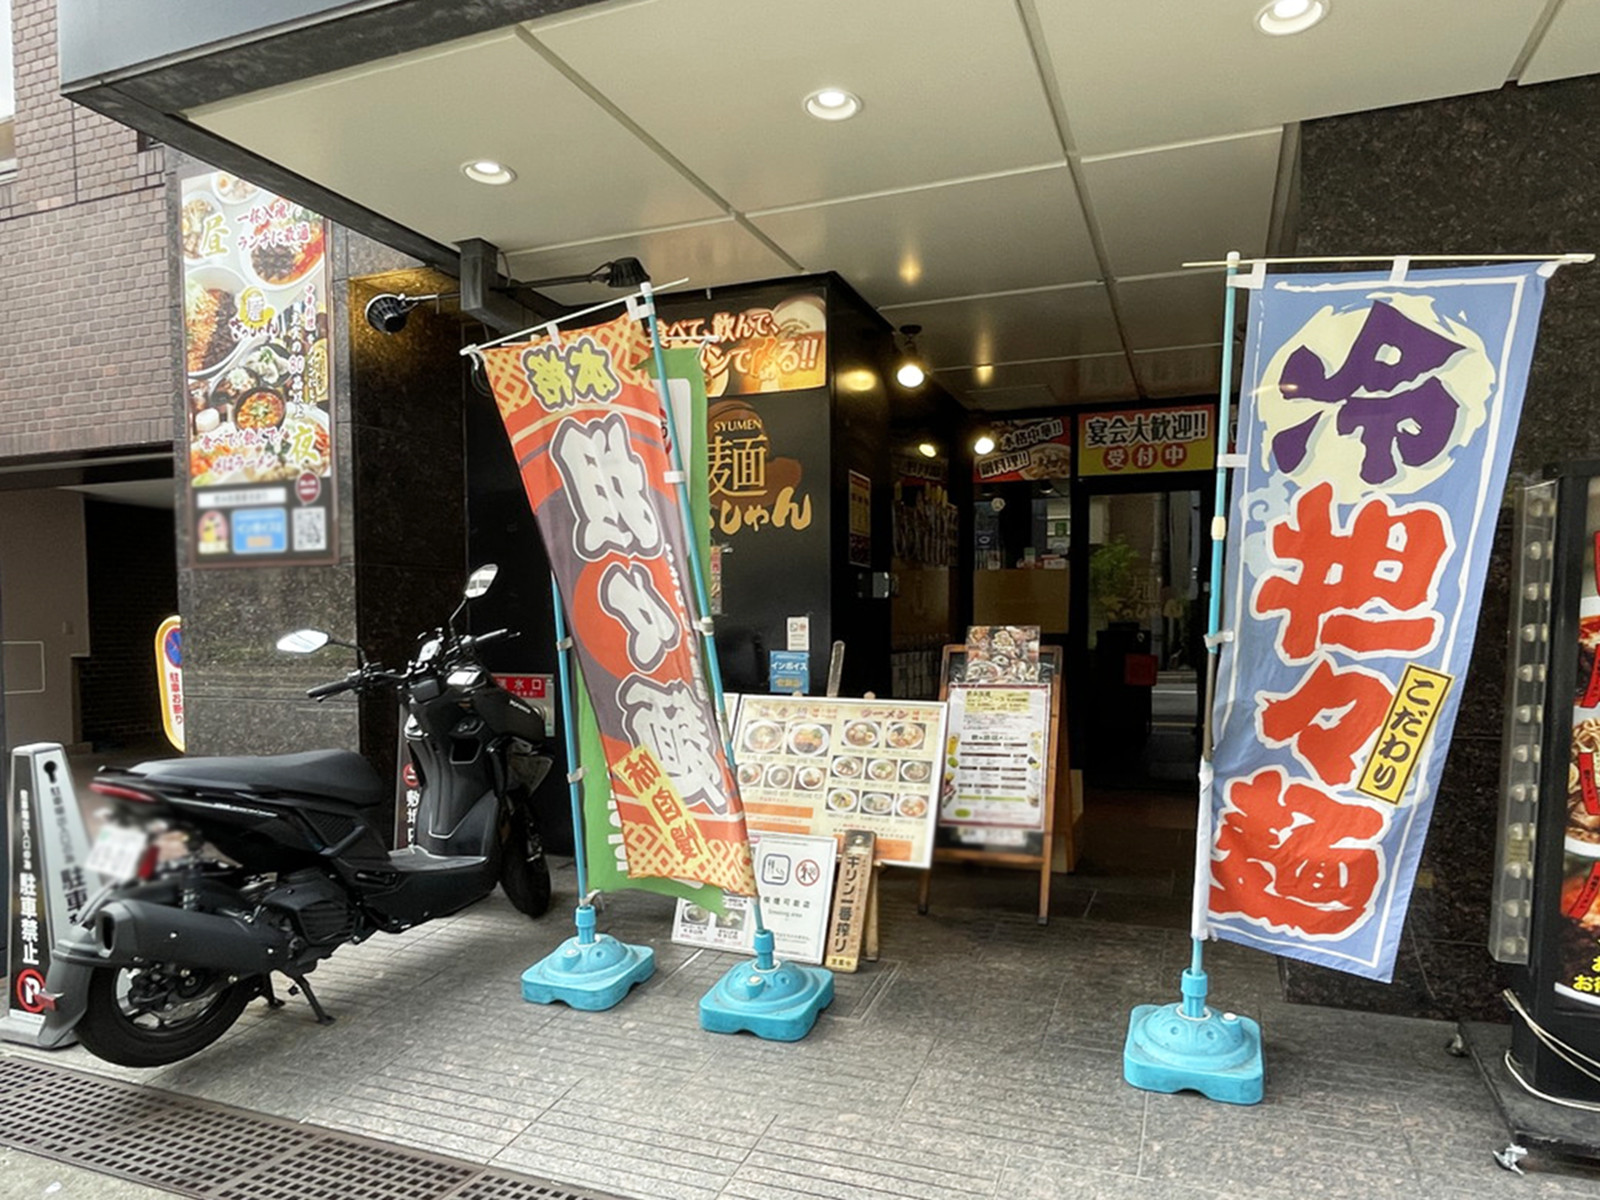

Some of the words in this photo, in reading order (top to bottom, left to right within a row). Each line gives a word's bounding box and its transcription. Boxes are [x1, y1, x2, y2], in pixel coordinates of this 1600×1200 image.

[204, 216, 229, 255] 昼
[292, 425, 318, 463] 夜
[714, 419, 762, 433] SYUMEN
[1087, 411, 1208, 446] 宴会大歓迎!!
[1107, 445, 1184, 468] 受付中
[708, 486, 811, 534] しゃん
[1373, 678, 1436, 791] こだわり
[61, 865, 88, 925] 駐車
[20, 873, 40, 966] 駐車禁止
